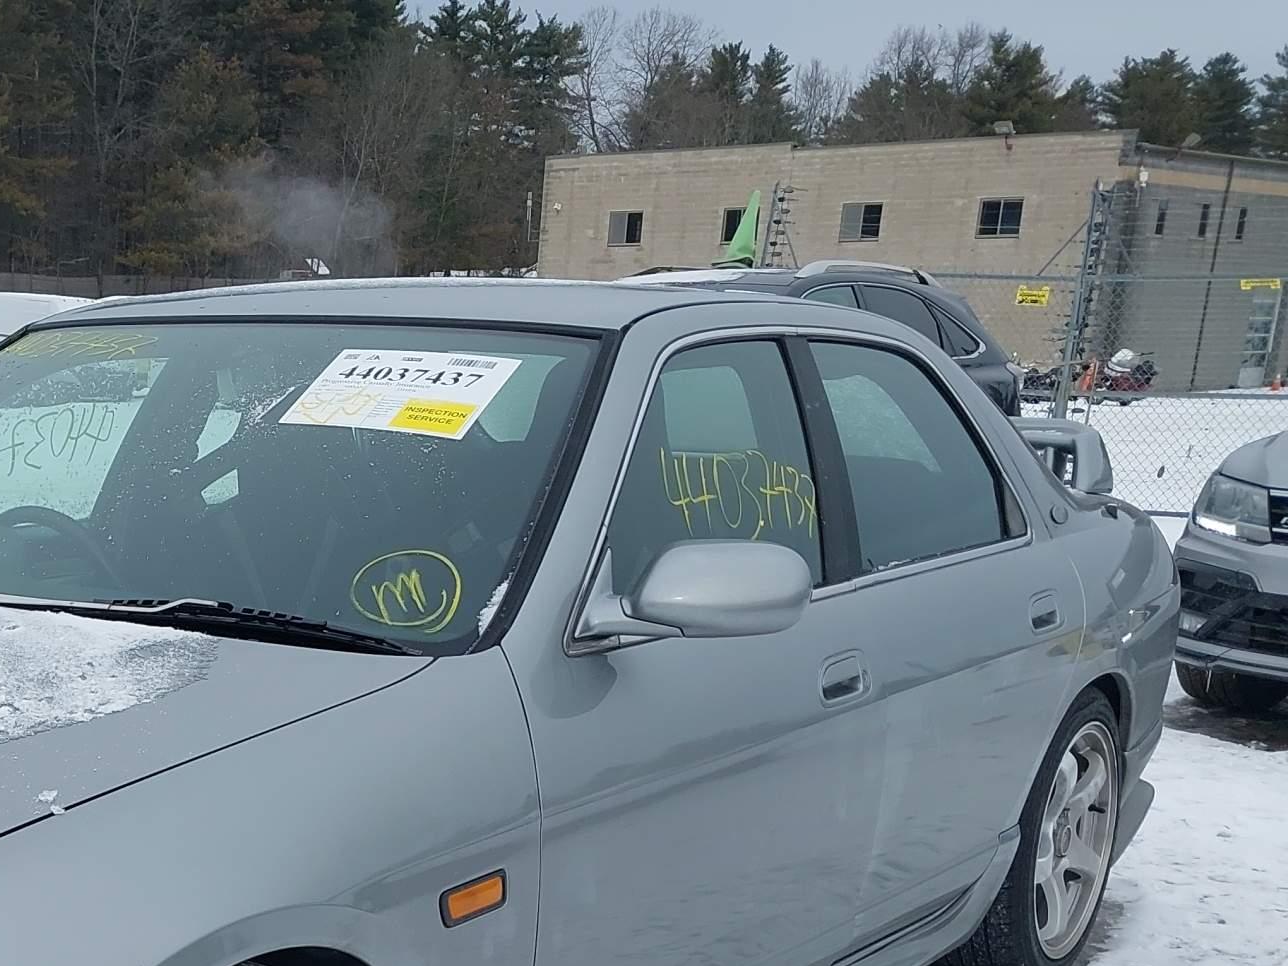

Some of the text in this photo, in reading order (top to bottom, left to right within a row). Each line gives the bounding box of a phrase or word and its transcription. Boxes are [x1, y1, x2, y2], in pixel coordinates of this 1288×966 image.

[339, 365, 485, 388] 44037437
[404, 406, 469, 418] INSPECTION
[407, 414, 454, 424] SERVICE
[660, 448, 817, 540] 44037437
